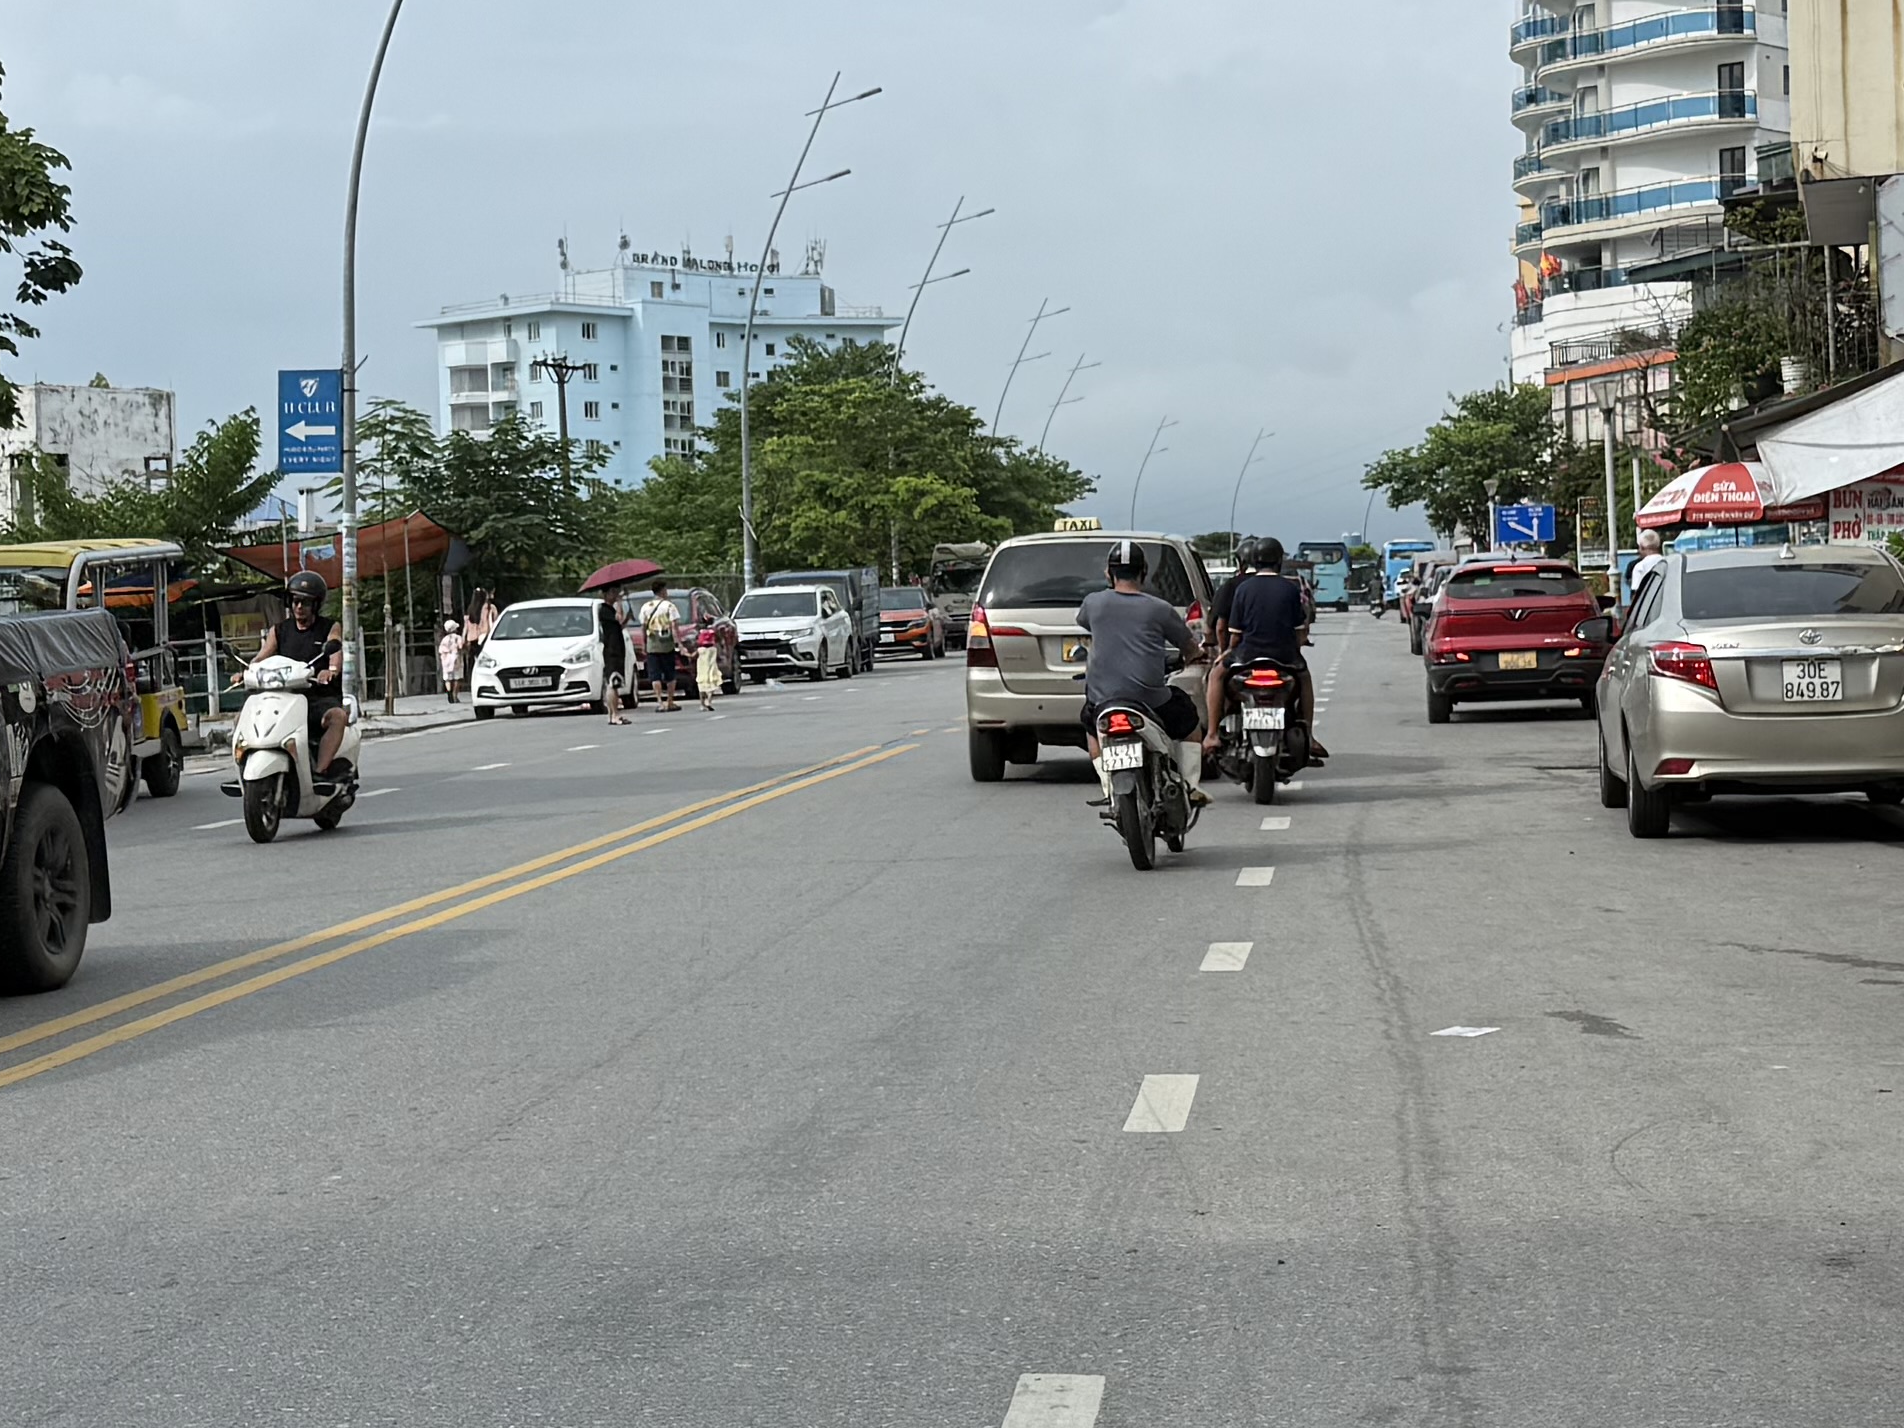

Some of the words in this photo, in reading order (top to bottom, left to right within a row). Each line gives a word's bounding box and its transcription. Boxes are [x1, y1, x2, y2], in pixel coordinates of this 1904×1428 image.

[632, 250, 678, 267] GRAND
[737, 261, 781, 274] Hoel
[1062, 520, 1094, 532] TAXI
[1796, 662, 1828, 680] 30E
[1784, 681, 1841, 700] 849.87
